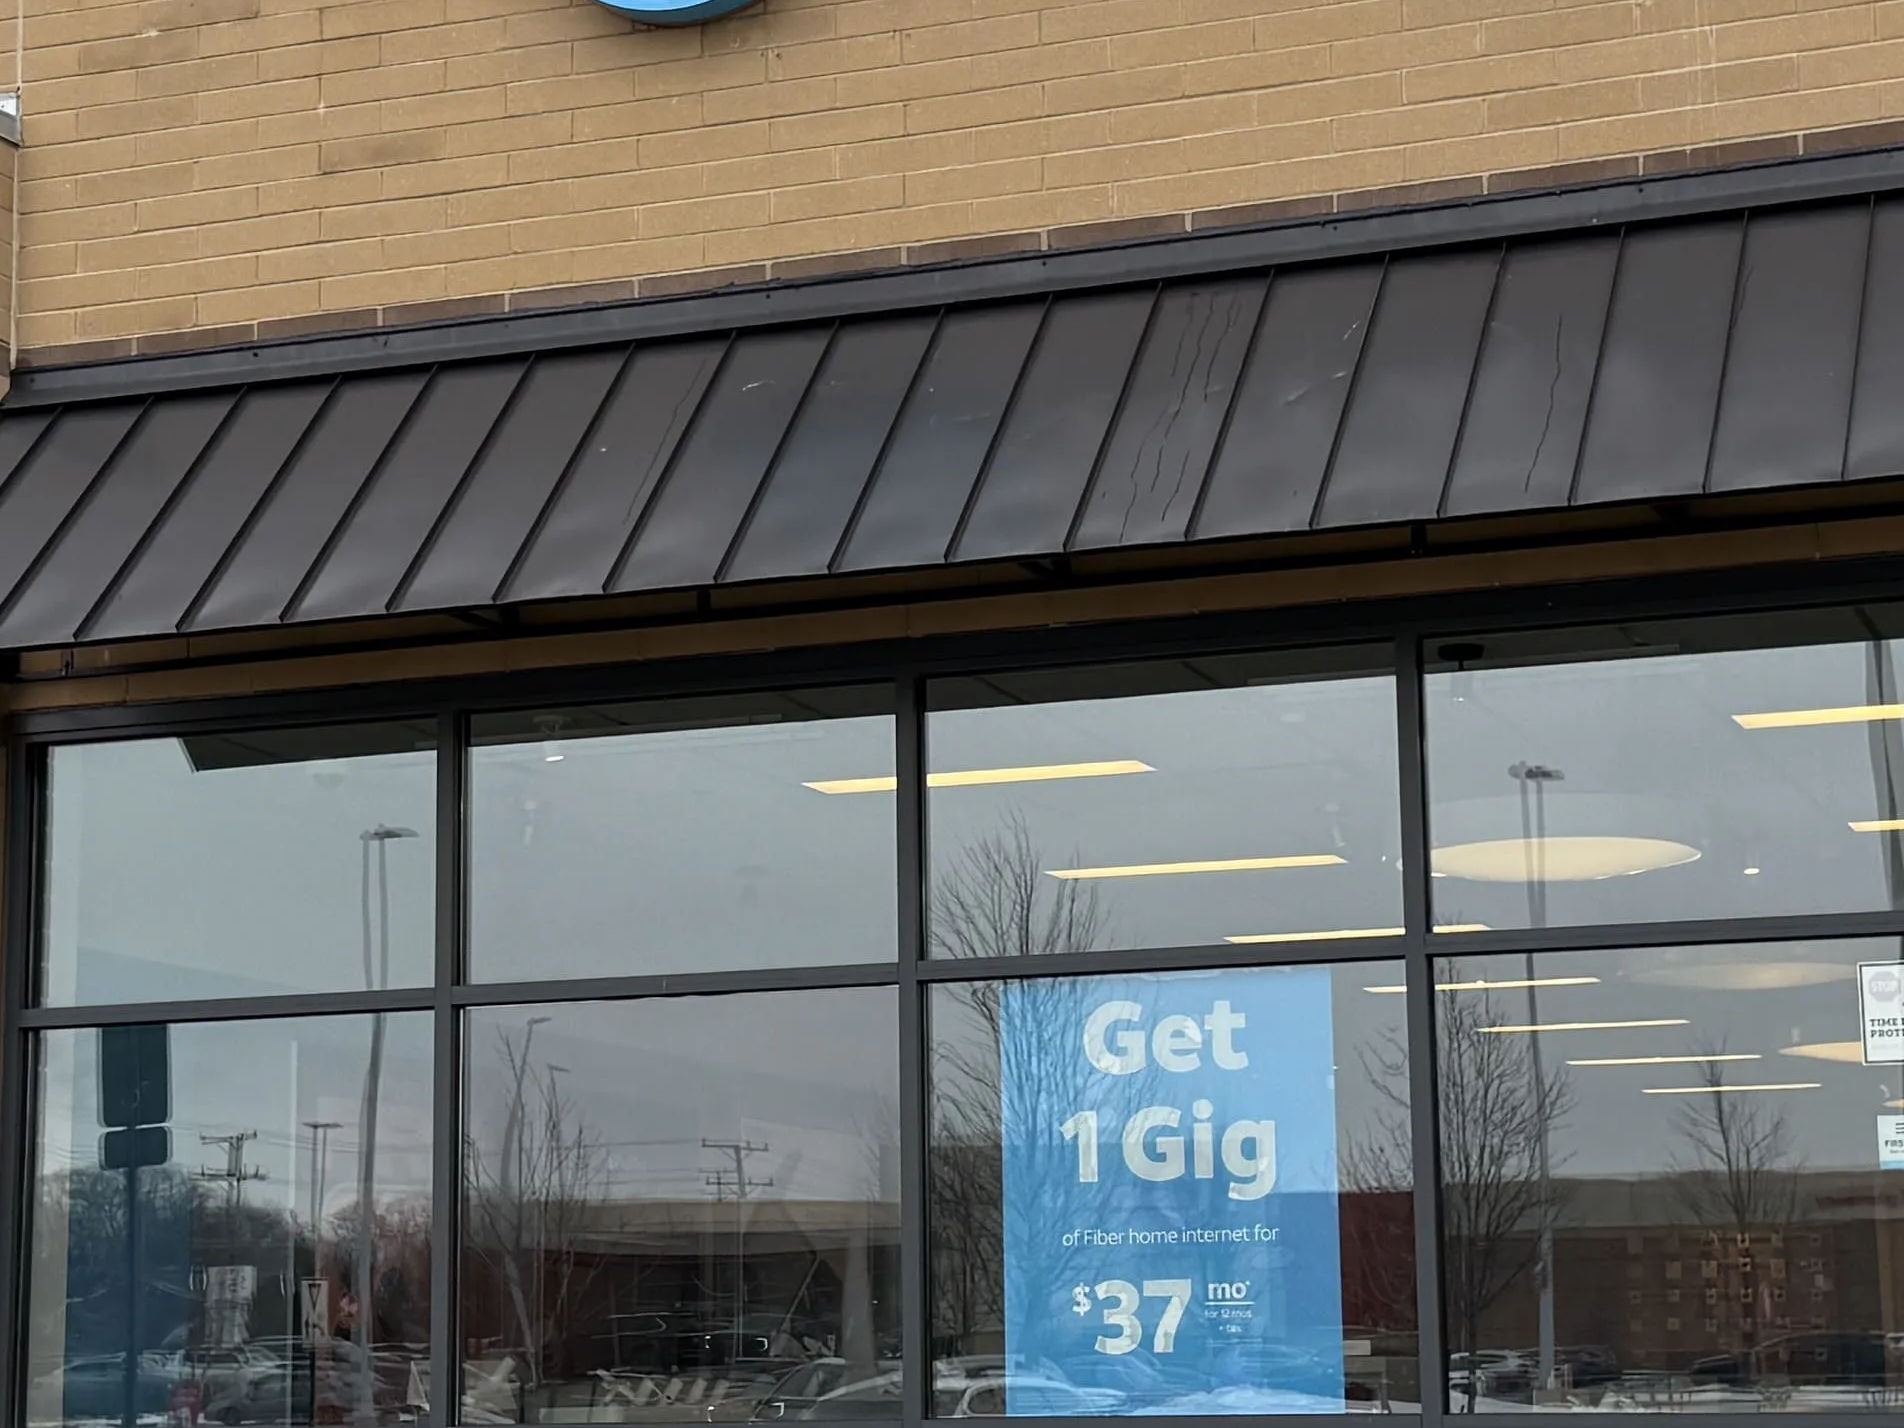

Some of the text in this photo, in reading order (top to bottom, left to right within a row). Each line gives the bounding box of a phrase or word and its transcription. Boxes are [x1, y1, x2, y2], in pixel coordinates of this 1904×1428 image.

[1084, 1000, 1249, 1075] Get
[1870, 1018, 1898, 1027] TIME
[1060, 1099, 1277, 1201] 1 Gig
[1062, 1224, 1280, 1246] of Fiber home internet for
[1072, 1279, 1192, 1355] $37
